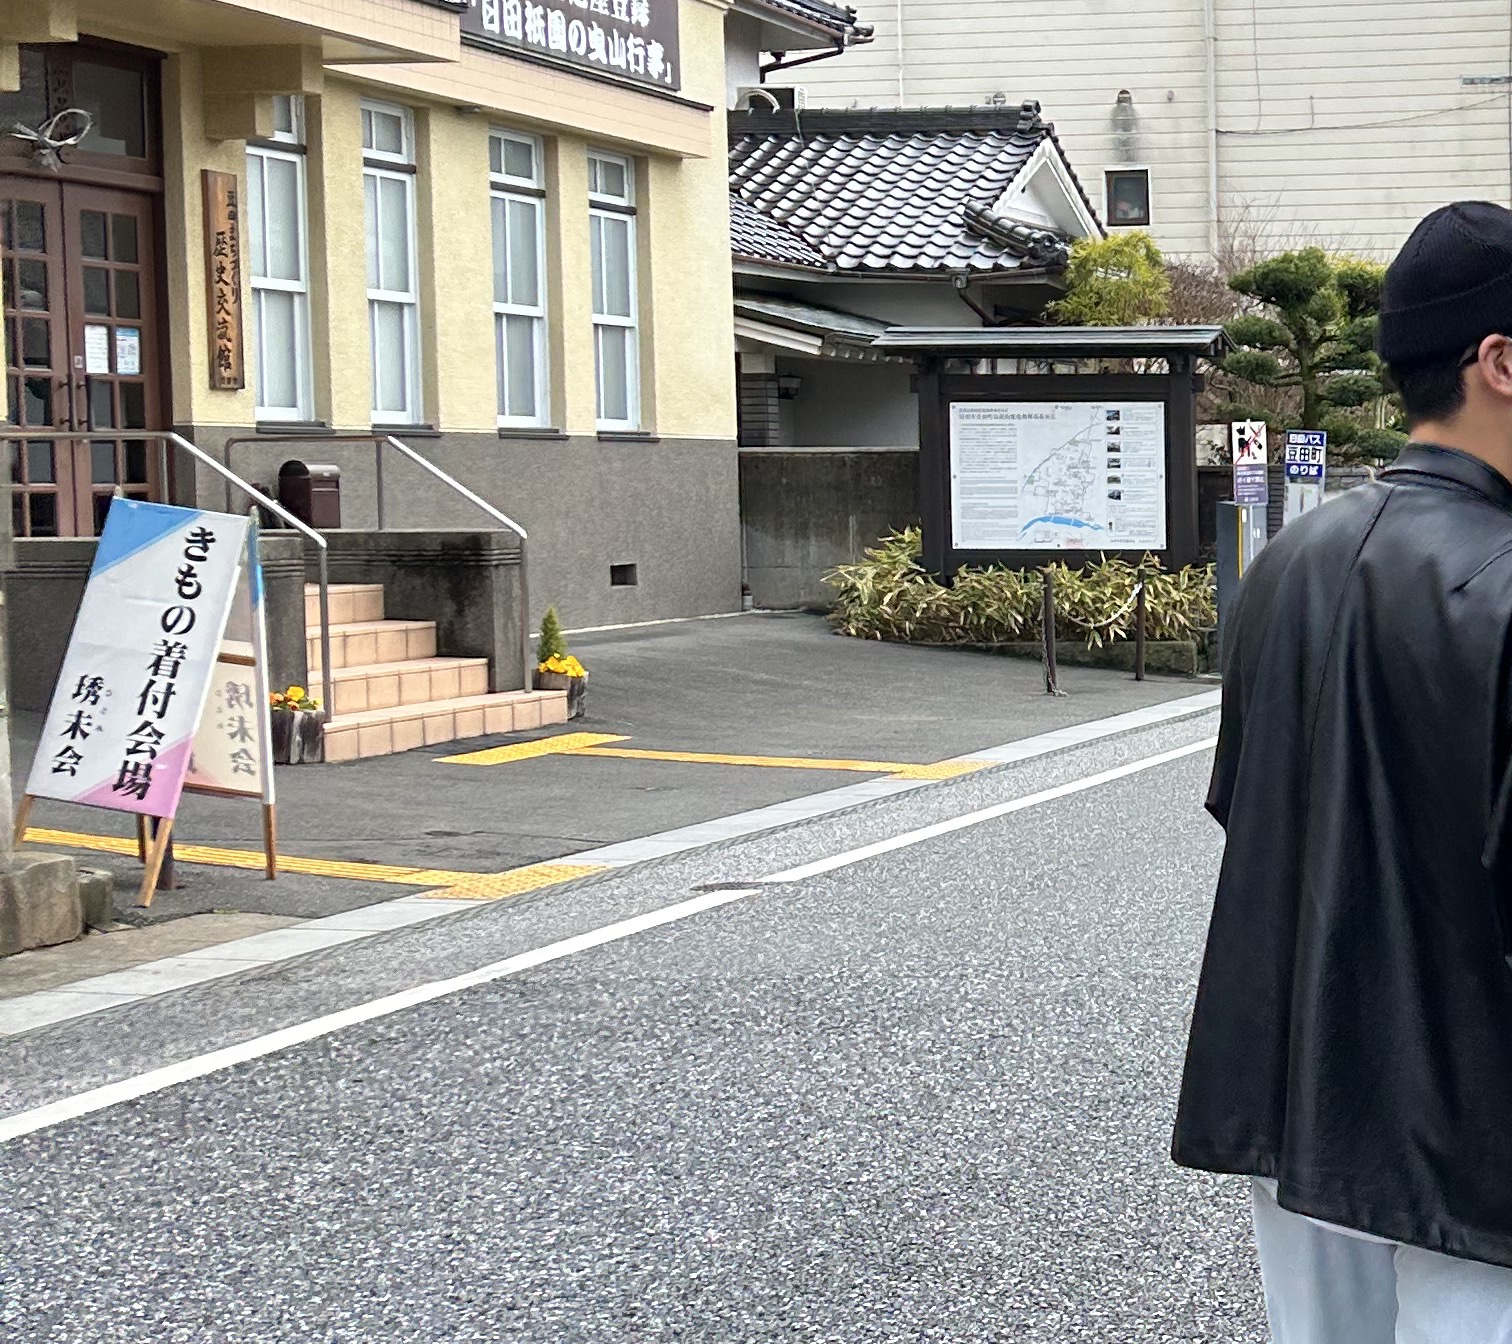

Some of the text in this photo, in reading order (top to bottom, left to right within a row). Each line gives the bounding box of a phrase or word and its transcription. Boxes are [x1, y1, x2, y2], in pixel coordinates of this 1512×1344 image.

[1286, 446, 1322, 463] 豆田町
[1289, 464, 1319, 476] のりば
[112, 526, 217, 801] きもの着付会場
